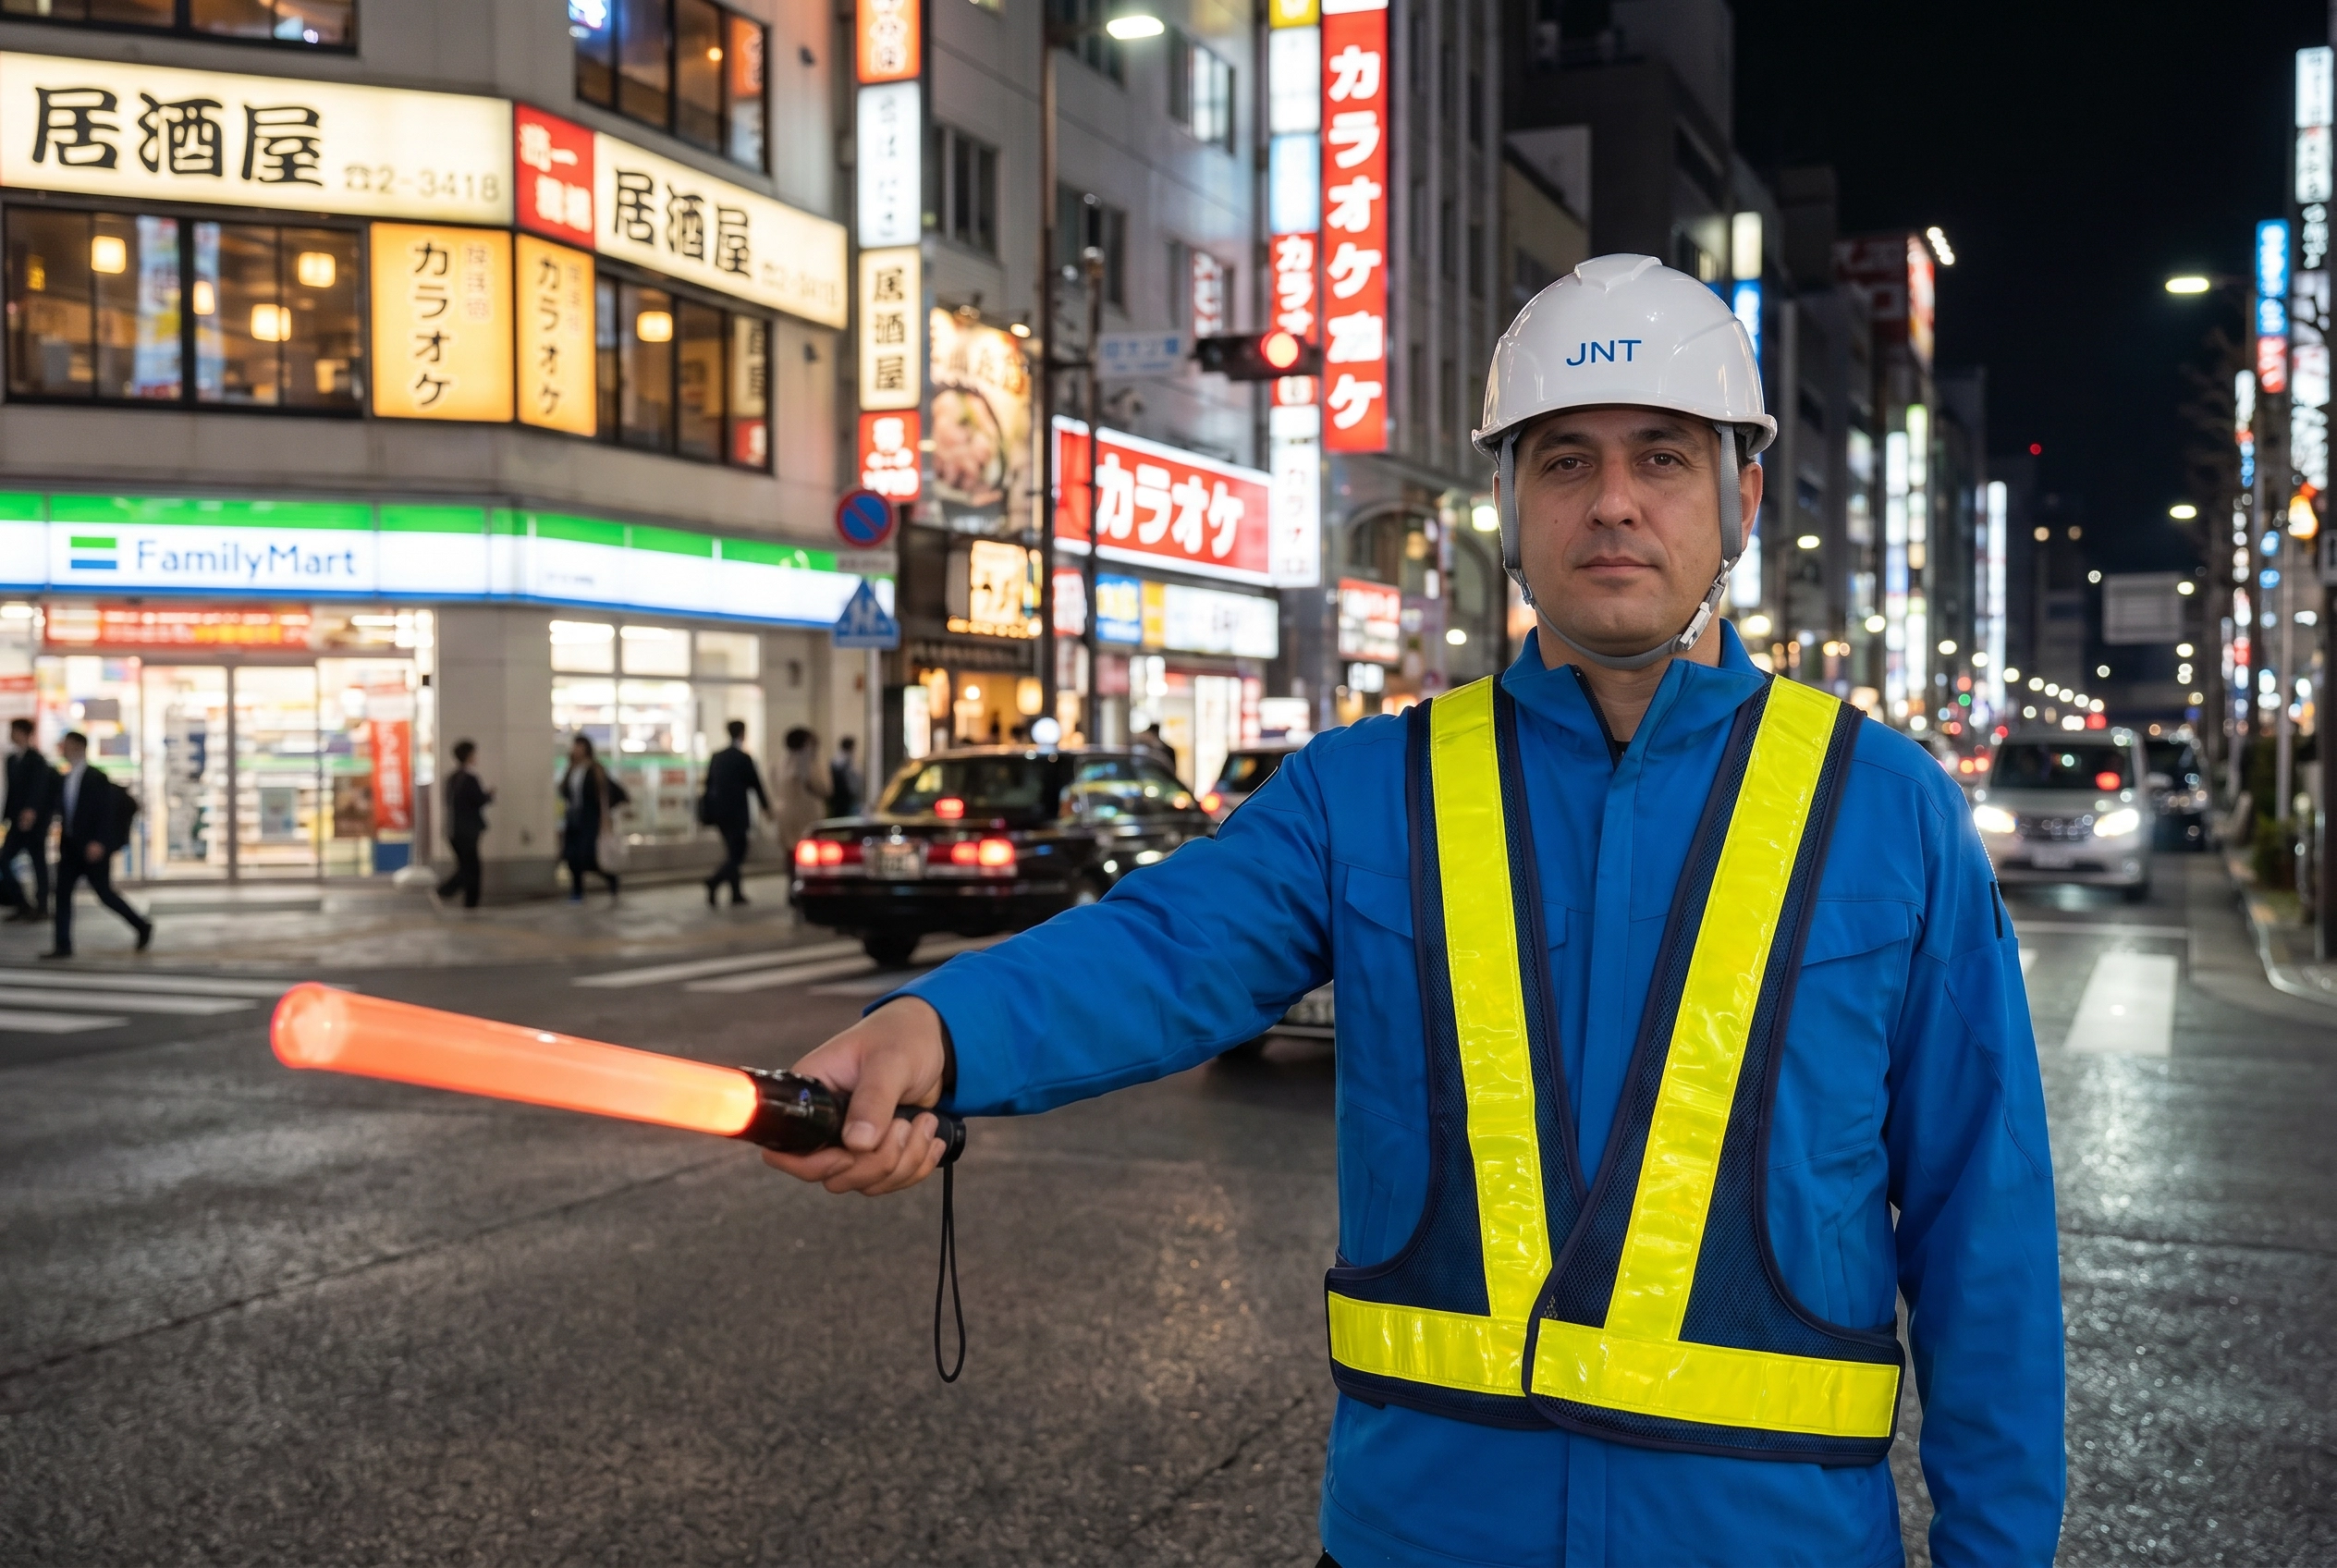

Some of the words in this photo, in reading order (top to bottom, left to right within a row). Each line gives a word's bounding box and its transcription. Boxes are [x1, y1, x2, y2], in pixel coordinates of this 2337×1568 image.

[32, 87, 323, 186] 居酒屋
[615, 169, 751, 277] 居酒屋
[415, 242, 450, 406] カラオケ
[539, 256, 559, 415] カラオケ
[1566, 339, 1642, 366] JNT
[1095, 452, 1244, 559] カラオケ
[138, 540, 355, 579] FamilyMart
